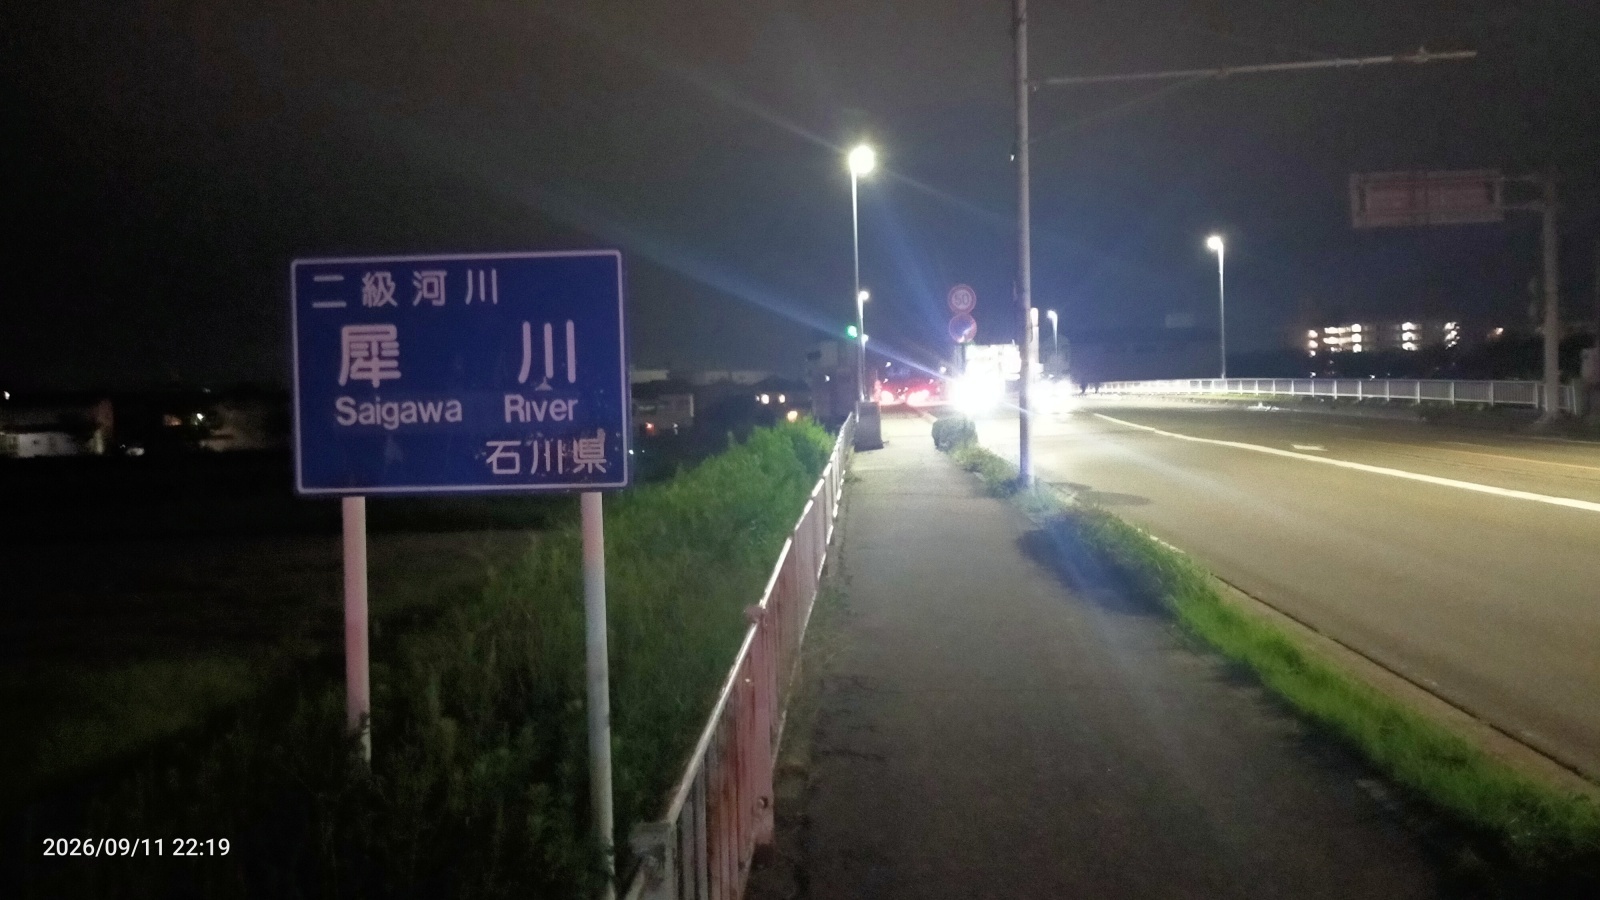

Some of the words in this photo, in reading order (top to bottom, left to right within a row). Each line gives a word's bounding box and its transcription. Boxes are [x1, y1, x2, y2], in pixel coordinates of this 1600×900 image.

[312, 268, 498, 308] 二級河川
[953, 292, 970, 306] 50
[335, 396, 463, 430] Saigawa
[504, 394, 578, 423] River
[486, 434, 607, 475] 石川県
